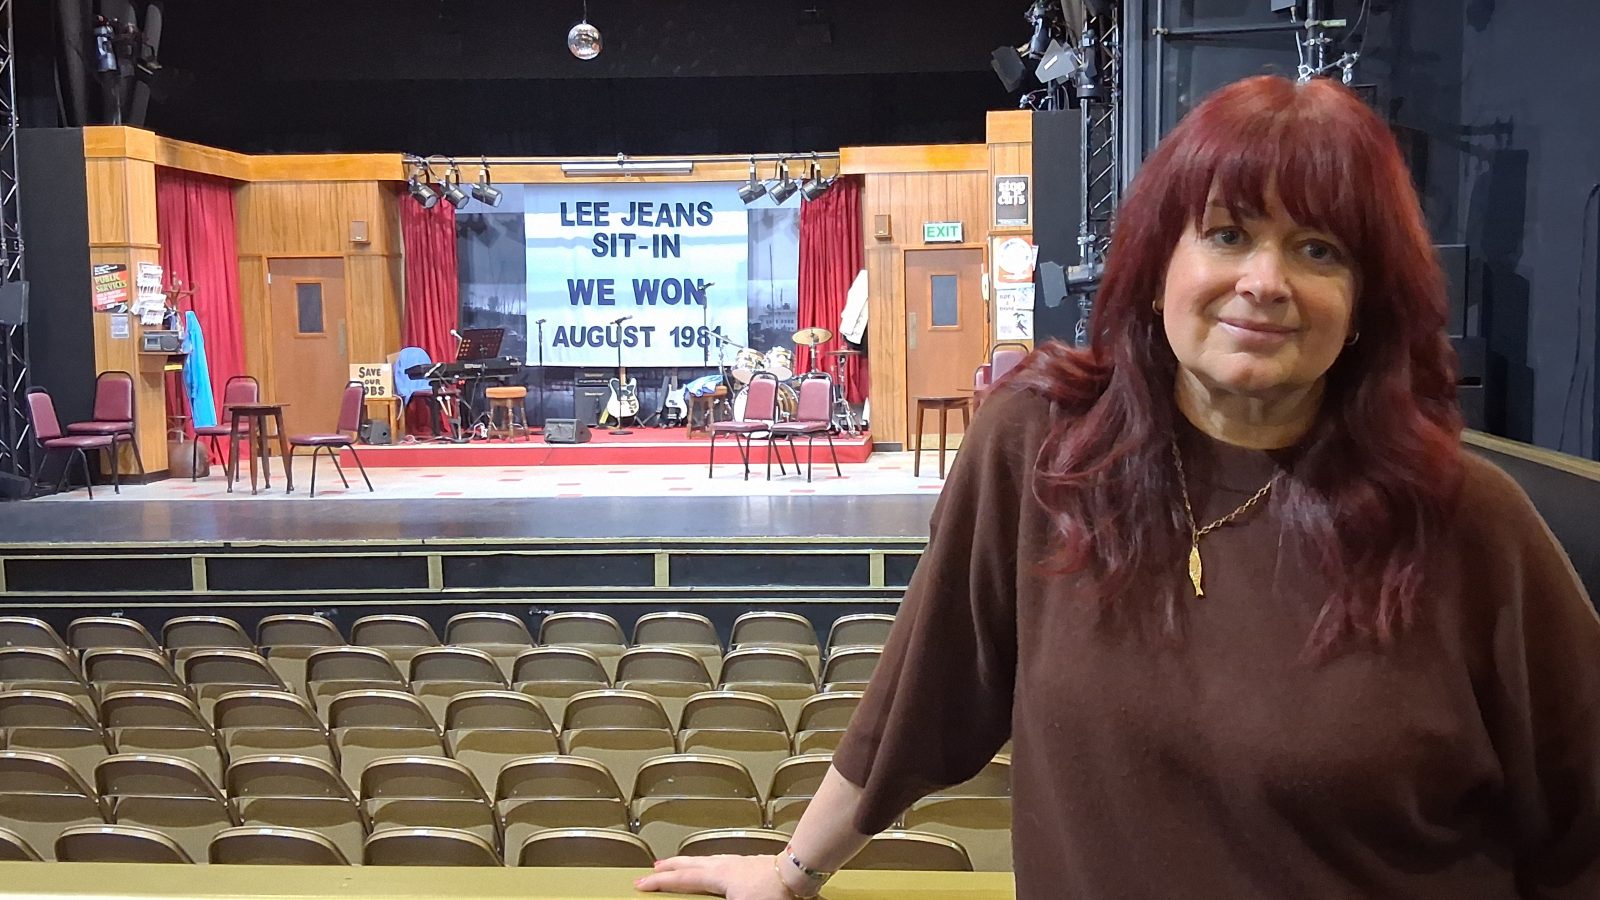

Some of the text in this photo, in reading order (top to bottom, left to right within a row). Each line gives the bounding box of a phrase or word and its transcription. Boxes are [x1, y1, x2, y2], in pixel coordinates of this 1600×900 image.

[560, 201, 714, 228] LEE JEANS
[926, 225, 959, 238] EXIT
[591, 232, 681, 259] SIT-IN
[94, 273, 120, 285] PUBLIC
[95, 280, 128, 294] SERVICES
[567, 277, 706, 306] WE WON
[552, 325, 722, 348] AUGUST 1981
[358, 366, 382, 379] SAVE
[363, 386, 386, 396] OBS
